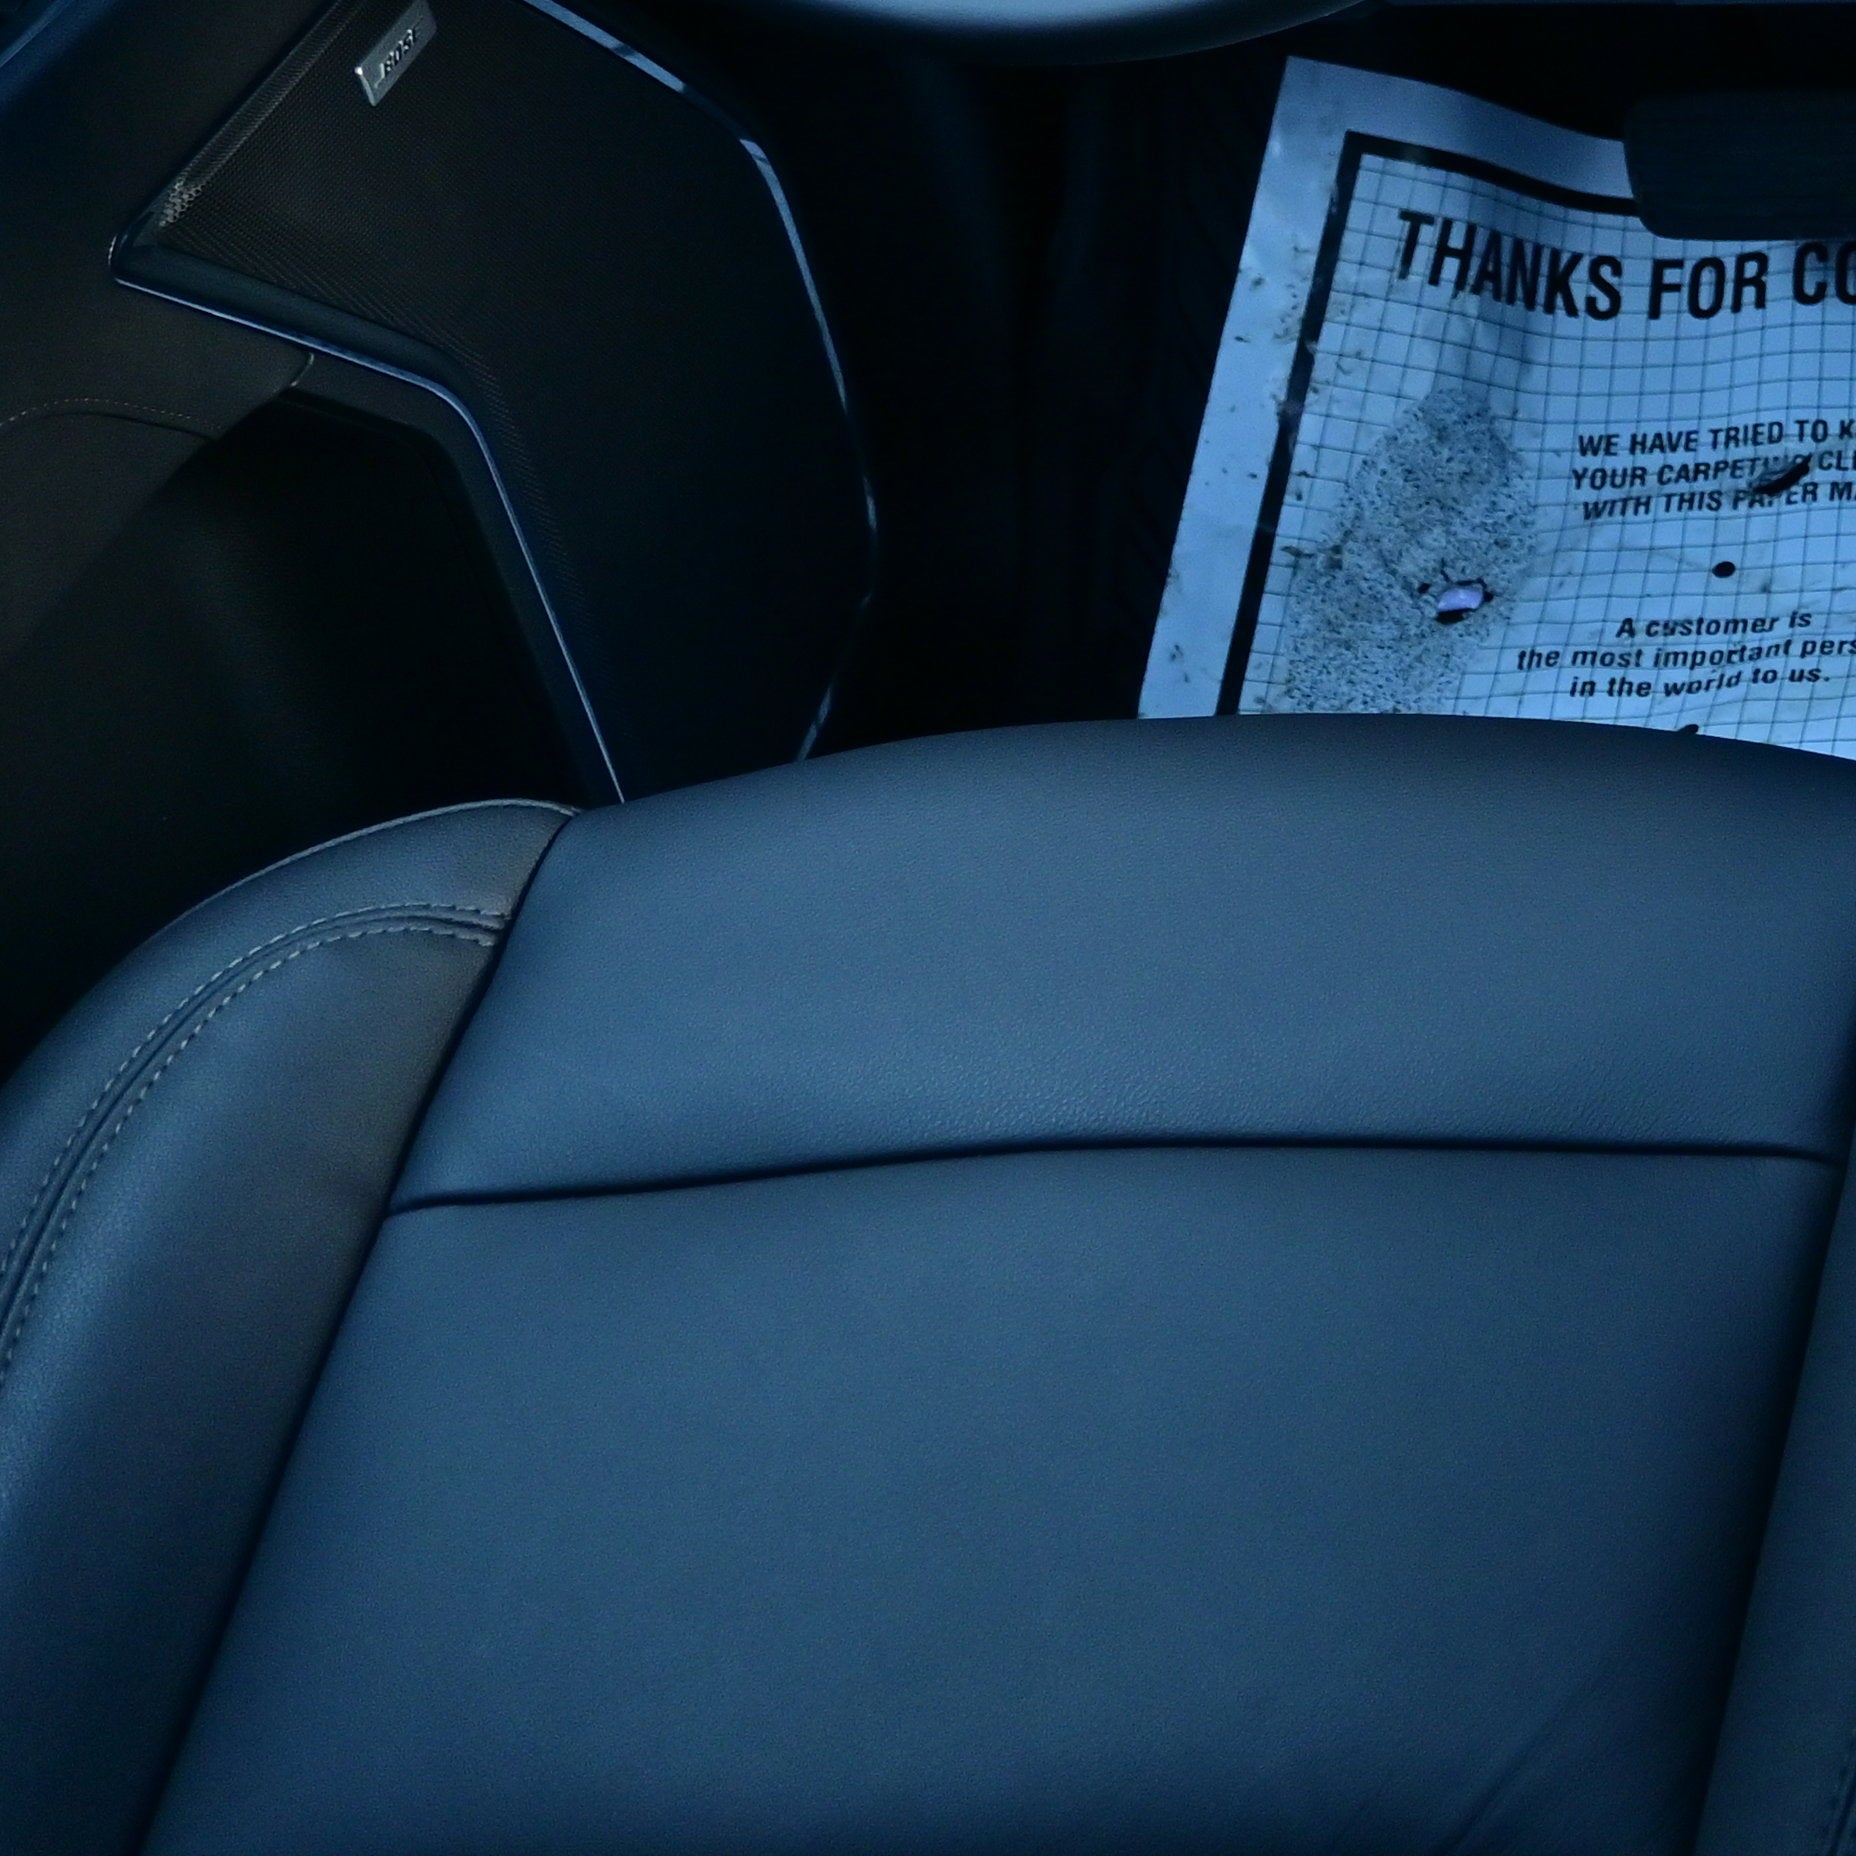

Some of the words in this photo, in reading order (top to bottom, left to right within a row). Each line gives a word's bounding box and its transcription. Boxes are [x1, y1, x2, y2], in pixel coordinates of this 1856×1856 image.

[1397, 207, 1624, 321] THANKS
[1648, 251, 1769, 320] FOR
[1578, 434, 1620, 457] WE
[1629, 430, 1700, 456] HAVE
[1709, 420, 1784, 450] TRIED
[1795, 419, 1829, 444] TO
[1572, 465, 1648, 490] YOUR
[1583, 496, 1651, 520] WITH
[1664, 491, 1723, 513] THIS
[1616, 618, 1635, 638] A
[1645, 615, 1779, 639] customer
[1788, 610, 1812, 629] is
[1517, 647, 1560, 671] the
[1571, 647, 1643, 669] most
[1653, 638, 1792, 672] important
[1569, 676, 1597, 698] in
[1606, 677, 1652, 697] the
[1663, 670, 1741, 696] world
[1752, 668, 1778, 685] to
[1788, 666, 1830, 684] us.
